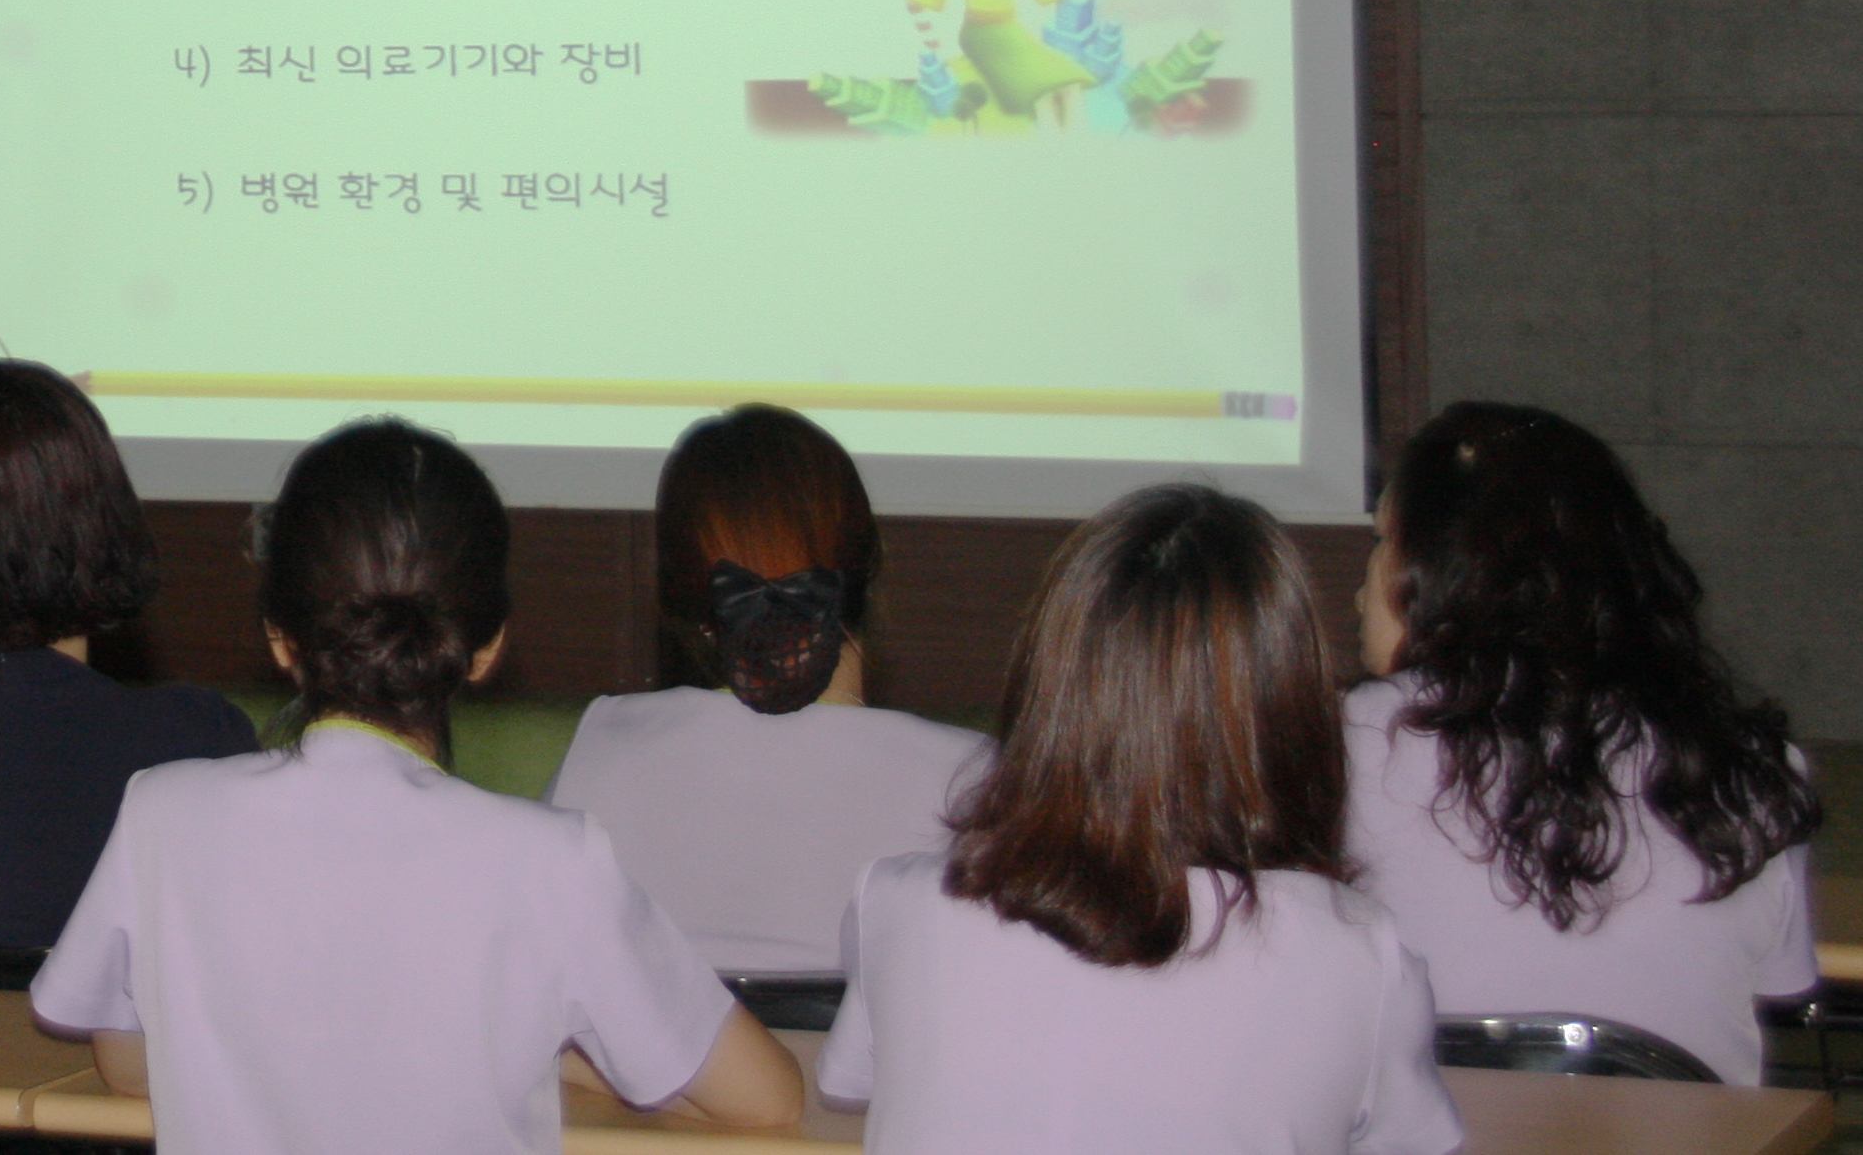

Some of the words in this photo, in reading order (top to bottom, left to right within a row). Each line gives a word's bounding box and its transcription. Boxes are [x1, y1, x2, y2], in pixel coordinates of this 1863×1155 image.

[173, 45, 212, 88] 4)
[238, 45, 316, 84] 최신
[335, 43, 544, 80] 의료기기와
[560, 42, 642, 85] 장비
[177, 171, 215, 214] 5)
[241, 172, 319, 214] 병원
[338, 171, 423, 215] 환경
[441, 172, 482, 212] 및
[501, 172, 669, 219] 편의시설
